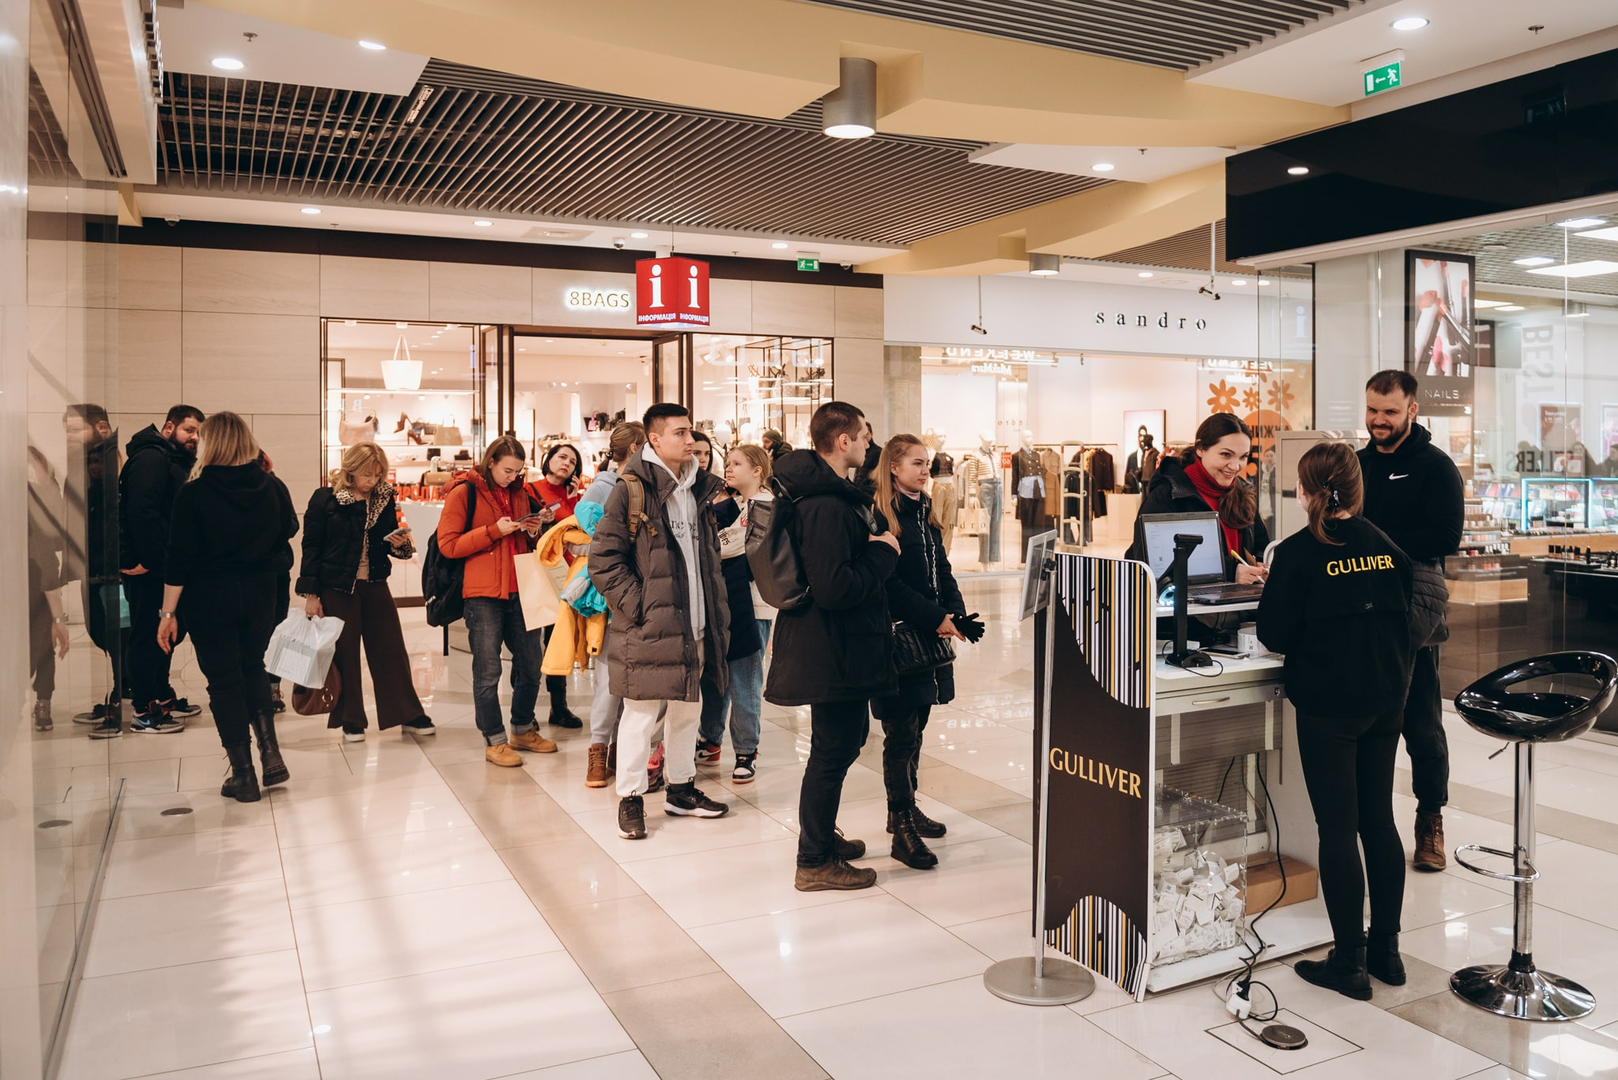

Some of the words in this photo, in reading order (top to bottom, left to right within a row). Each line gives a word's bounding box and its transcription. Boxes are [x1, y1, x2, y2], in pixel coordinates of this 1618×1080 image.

[569, 290, 630, 308] 8BAGS
[638, 312, 676, 322] ІНФОРМАЦІЯ
[1095, 311, 1206, 330] sandro
[1424, 389, 1459, 399] NAILS
[1326, 554, 1395, 576] GULLIVER
[1049, 747, 1142, 799] GULLIVER
